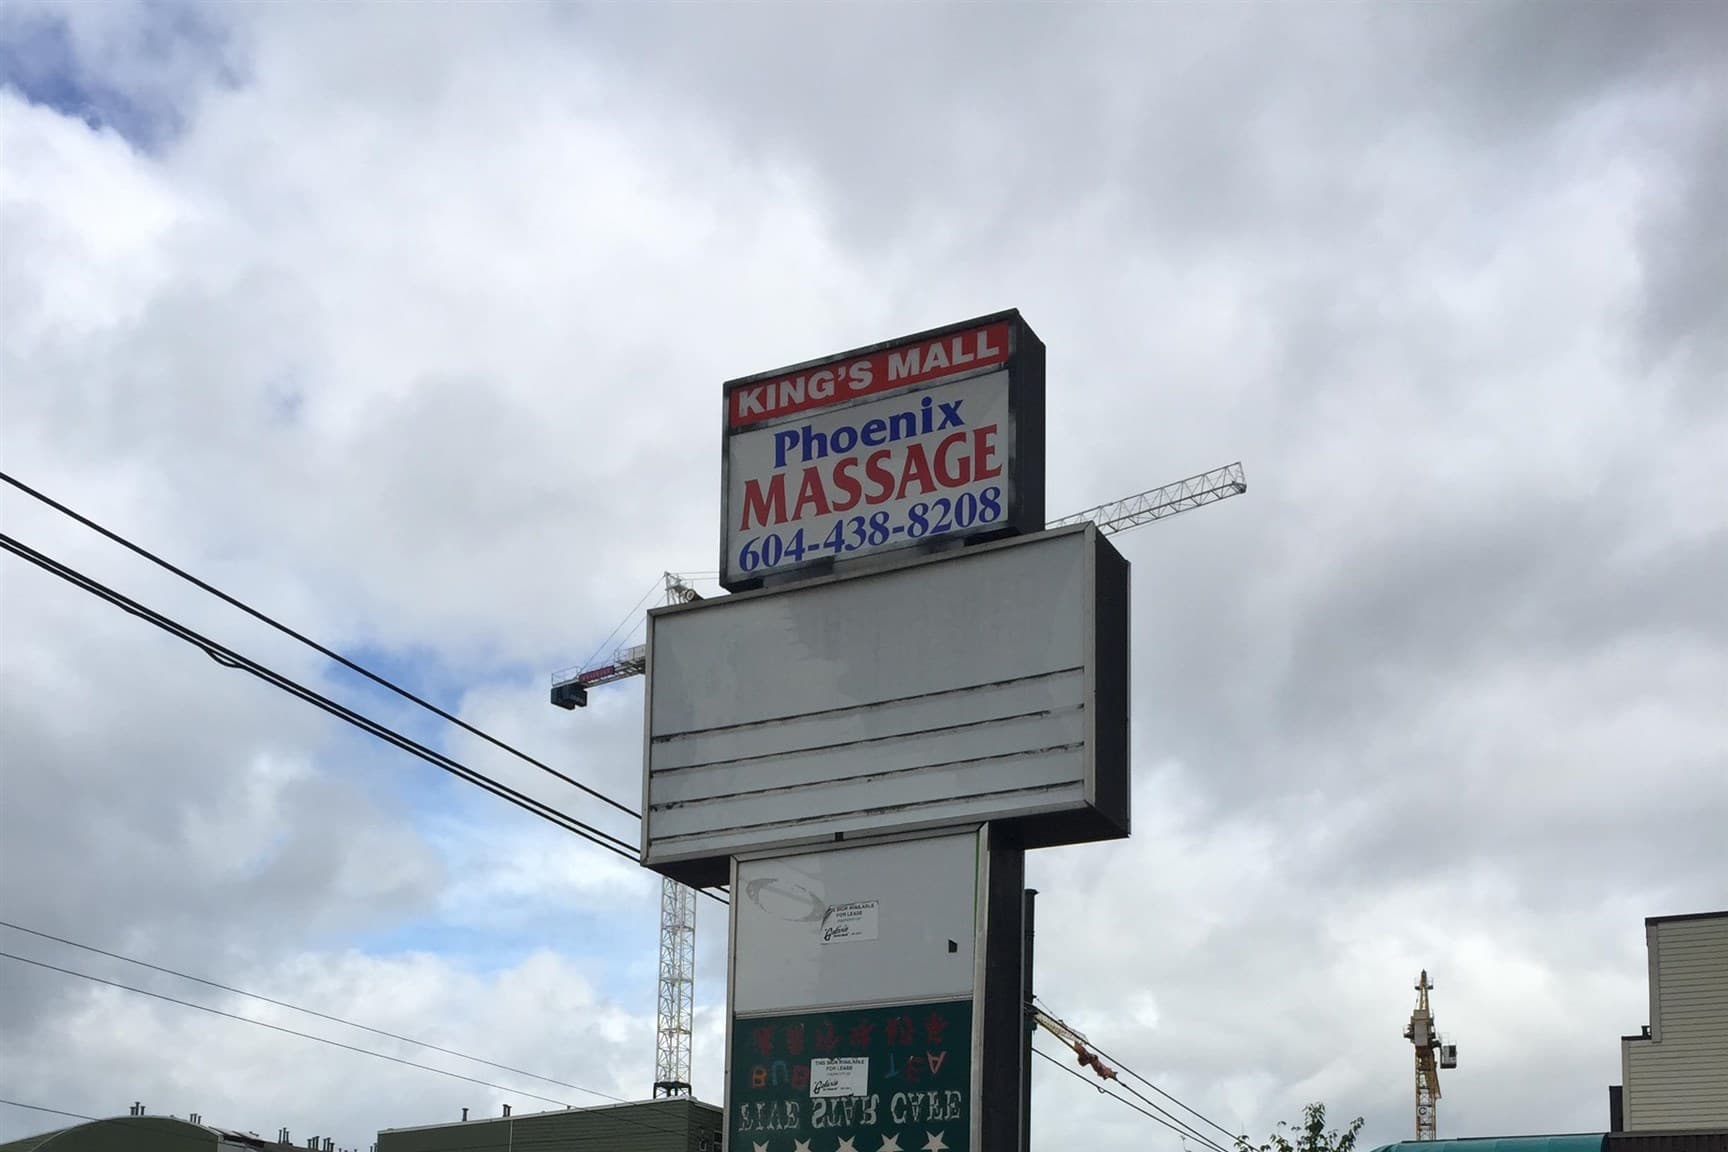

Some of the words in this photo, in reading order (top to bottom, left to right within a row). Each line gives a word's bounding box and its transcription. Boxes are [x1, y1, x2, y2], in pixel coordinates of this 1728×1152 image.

[738, 361, 873, 417] KING'S
[888, 330, 1000, 381] MALL
[774, 396, 965, 468] Phoenix
[739, 424, 1002, 532] MASSAGE
[739, 486, 1001, 573] 604-438-8208
